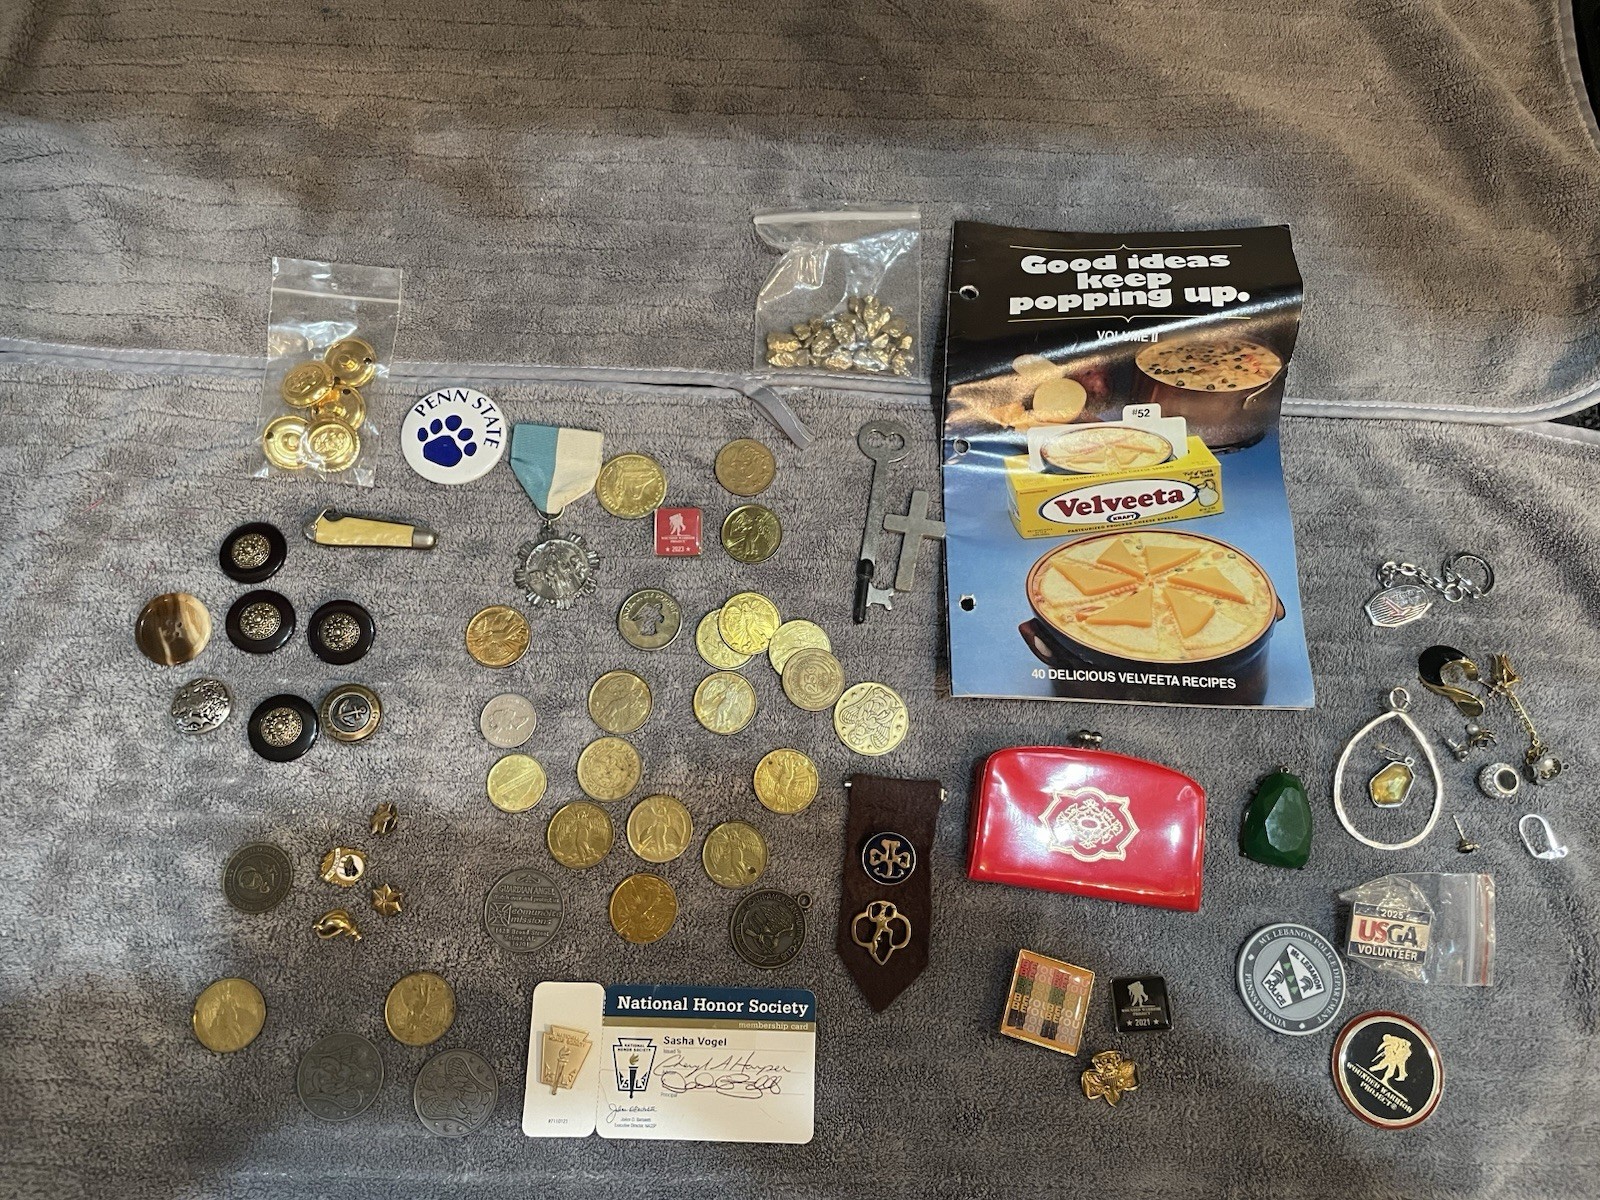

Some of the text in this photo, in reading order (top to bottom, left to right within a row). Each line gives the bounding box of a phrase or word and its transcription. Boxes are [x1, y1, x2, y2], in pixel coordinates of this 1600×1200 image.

[1020, 252, 1231, 275] Good ideas
[1077, 270, 1173, 291] keep
[1009, 284, 1251, 315] popping up.
[1097, 330, 1149, 343] VOLUME
[414, 389, 502, 449] PENN STATE
[1131, 408, 1151, 419] #52
[1054, 488, 1185, 518] Velveeta
[1031, 668, 1237, 690] 40 DELICIOUS VELVEETA RECIPES
[498, 885, 556, 896] GUARDIAN ANGEL
[1380, 908, 1404, 920] 2025
[1272, 928, 1314, 942] LEBANON
[1358, 919, 1418, 948] USGA
[1313, 938, 1337, 967] POLICE
[1357, 943, 1418, 961] VOLUNTEER
[1301, 957, 1323, 990] LEBANON
[1245, 973, 1287, 1028] PENNSYLVANIA
[1264, 979, 1287, 1006] POLICE
[1317, 968, 1342, 1023] DEPARTMENT
[616, 995, 809, 1018] National Honor Society
[738, 1022, 809, 1031] membership card
[1134, 1018, 1151, 1027] 2021
[663, 1036, 728, 1048] Sasha Vogel
[1346, 1061, 1413, 1113] WOUNDED WARRIOR
